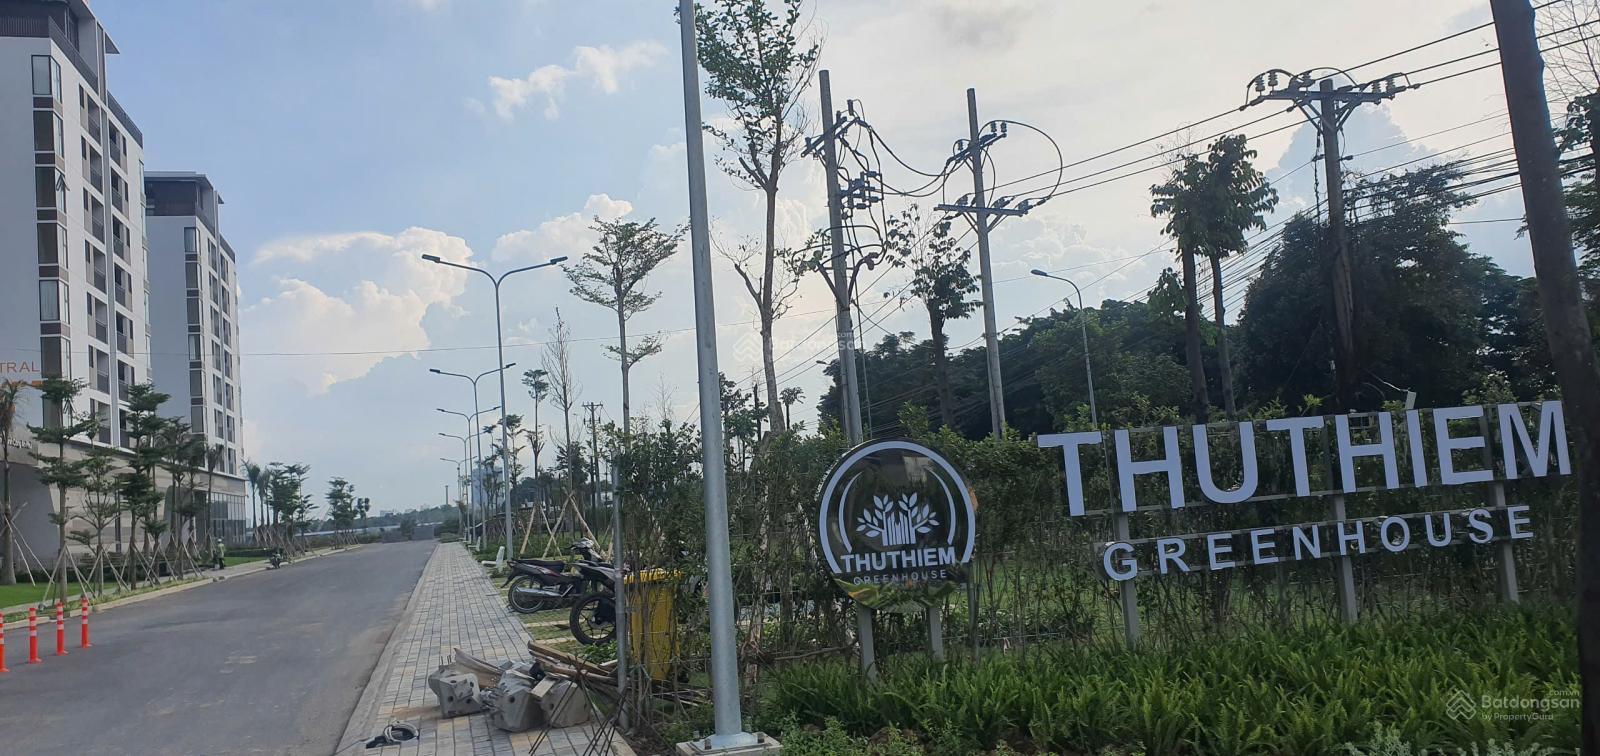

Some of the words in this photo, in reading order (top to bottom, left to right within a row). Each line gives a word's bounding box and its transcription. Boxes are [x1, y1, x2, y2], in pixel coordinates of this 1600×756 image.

[1037, 400, 1571, 517] THUTHIEM
[840, 546, 956, 573] THUTHIEM
[1103, 505, 1534, 582] GREENHOUSE
[853, 569, 947, 586] GREENHOUSE
